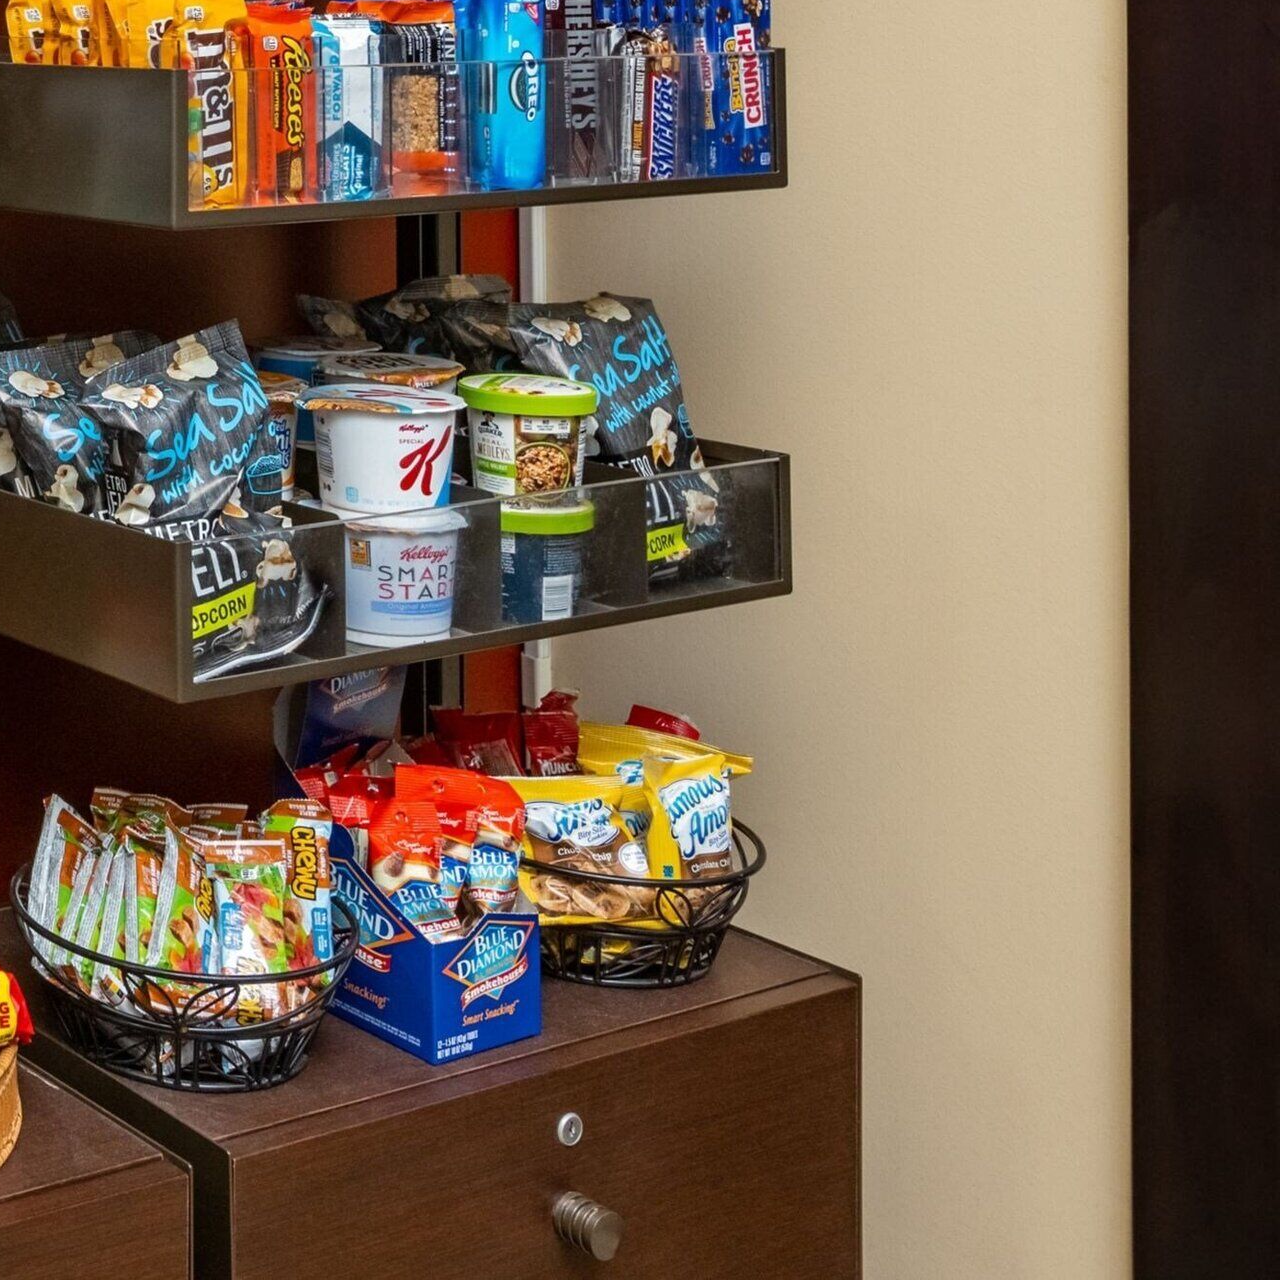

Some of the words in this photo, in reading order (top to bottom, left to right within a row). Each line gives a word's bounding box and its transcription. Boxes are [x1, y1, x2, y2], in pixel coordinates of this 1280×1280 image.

[282, 36, 312, 145] Reese's
[523, 52, 538, 121] OREO
[736, 25, 762, 127] CRUNCH
[613, 317, 669, 376] Salt
[146, 424, 212, 480] Sea
[470, 850, 510, 866] BLUE
[398, 887, 439, 909] BLUE
[457, 929, 525, 978] DIAMOND
[474, 930, 507, 954] BLUE
[463, 964, 527, 1003] Smokehouse
[462, 1011, 484, 1026] Smart
